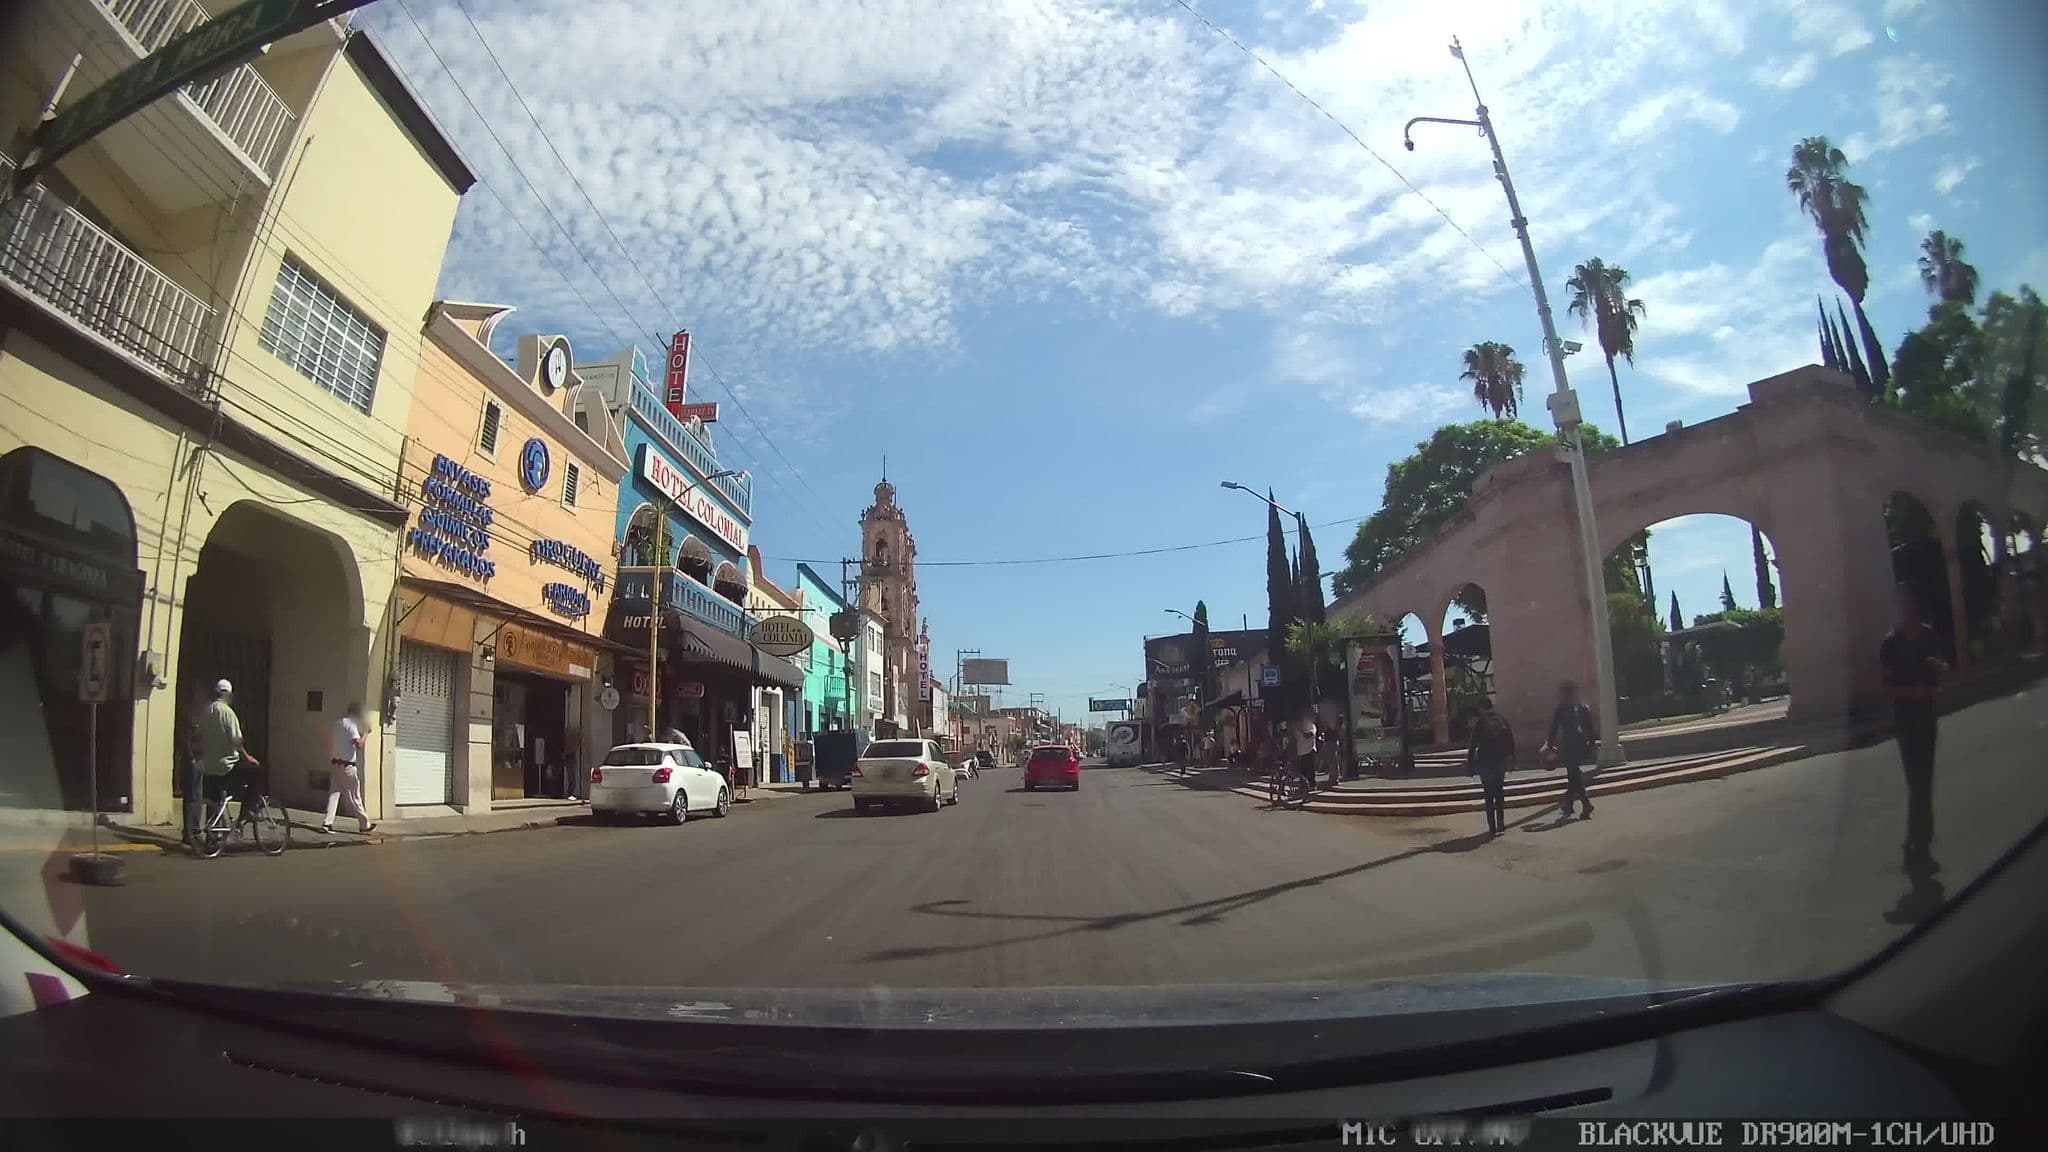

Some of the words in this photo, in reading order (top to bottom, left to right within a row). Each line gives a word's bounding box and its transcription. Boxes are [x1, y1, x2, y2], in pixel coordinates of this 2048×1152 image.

[669, 337, 687, 402] HOTE
[436, 453, 491, 497] ENVASES
[651, 455, 694, 512] HOTEL
[697, 498, 745, 550] COLONIAL
[411, 527, 495, 578] PREPARADOS
[761, 621, 790, 633] HOTEL
[1212, 647, 1237, 657] rona
[920, 653, 928, 699] HOTEL
